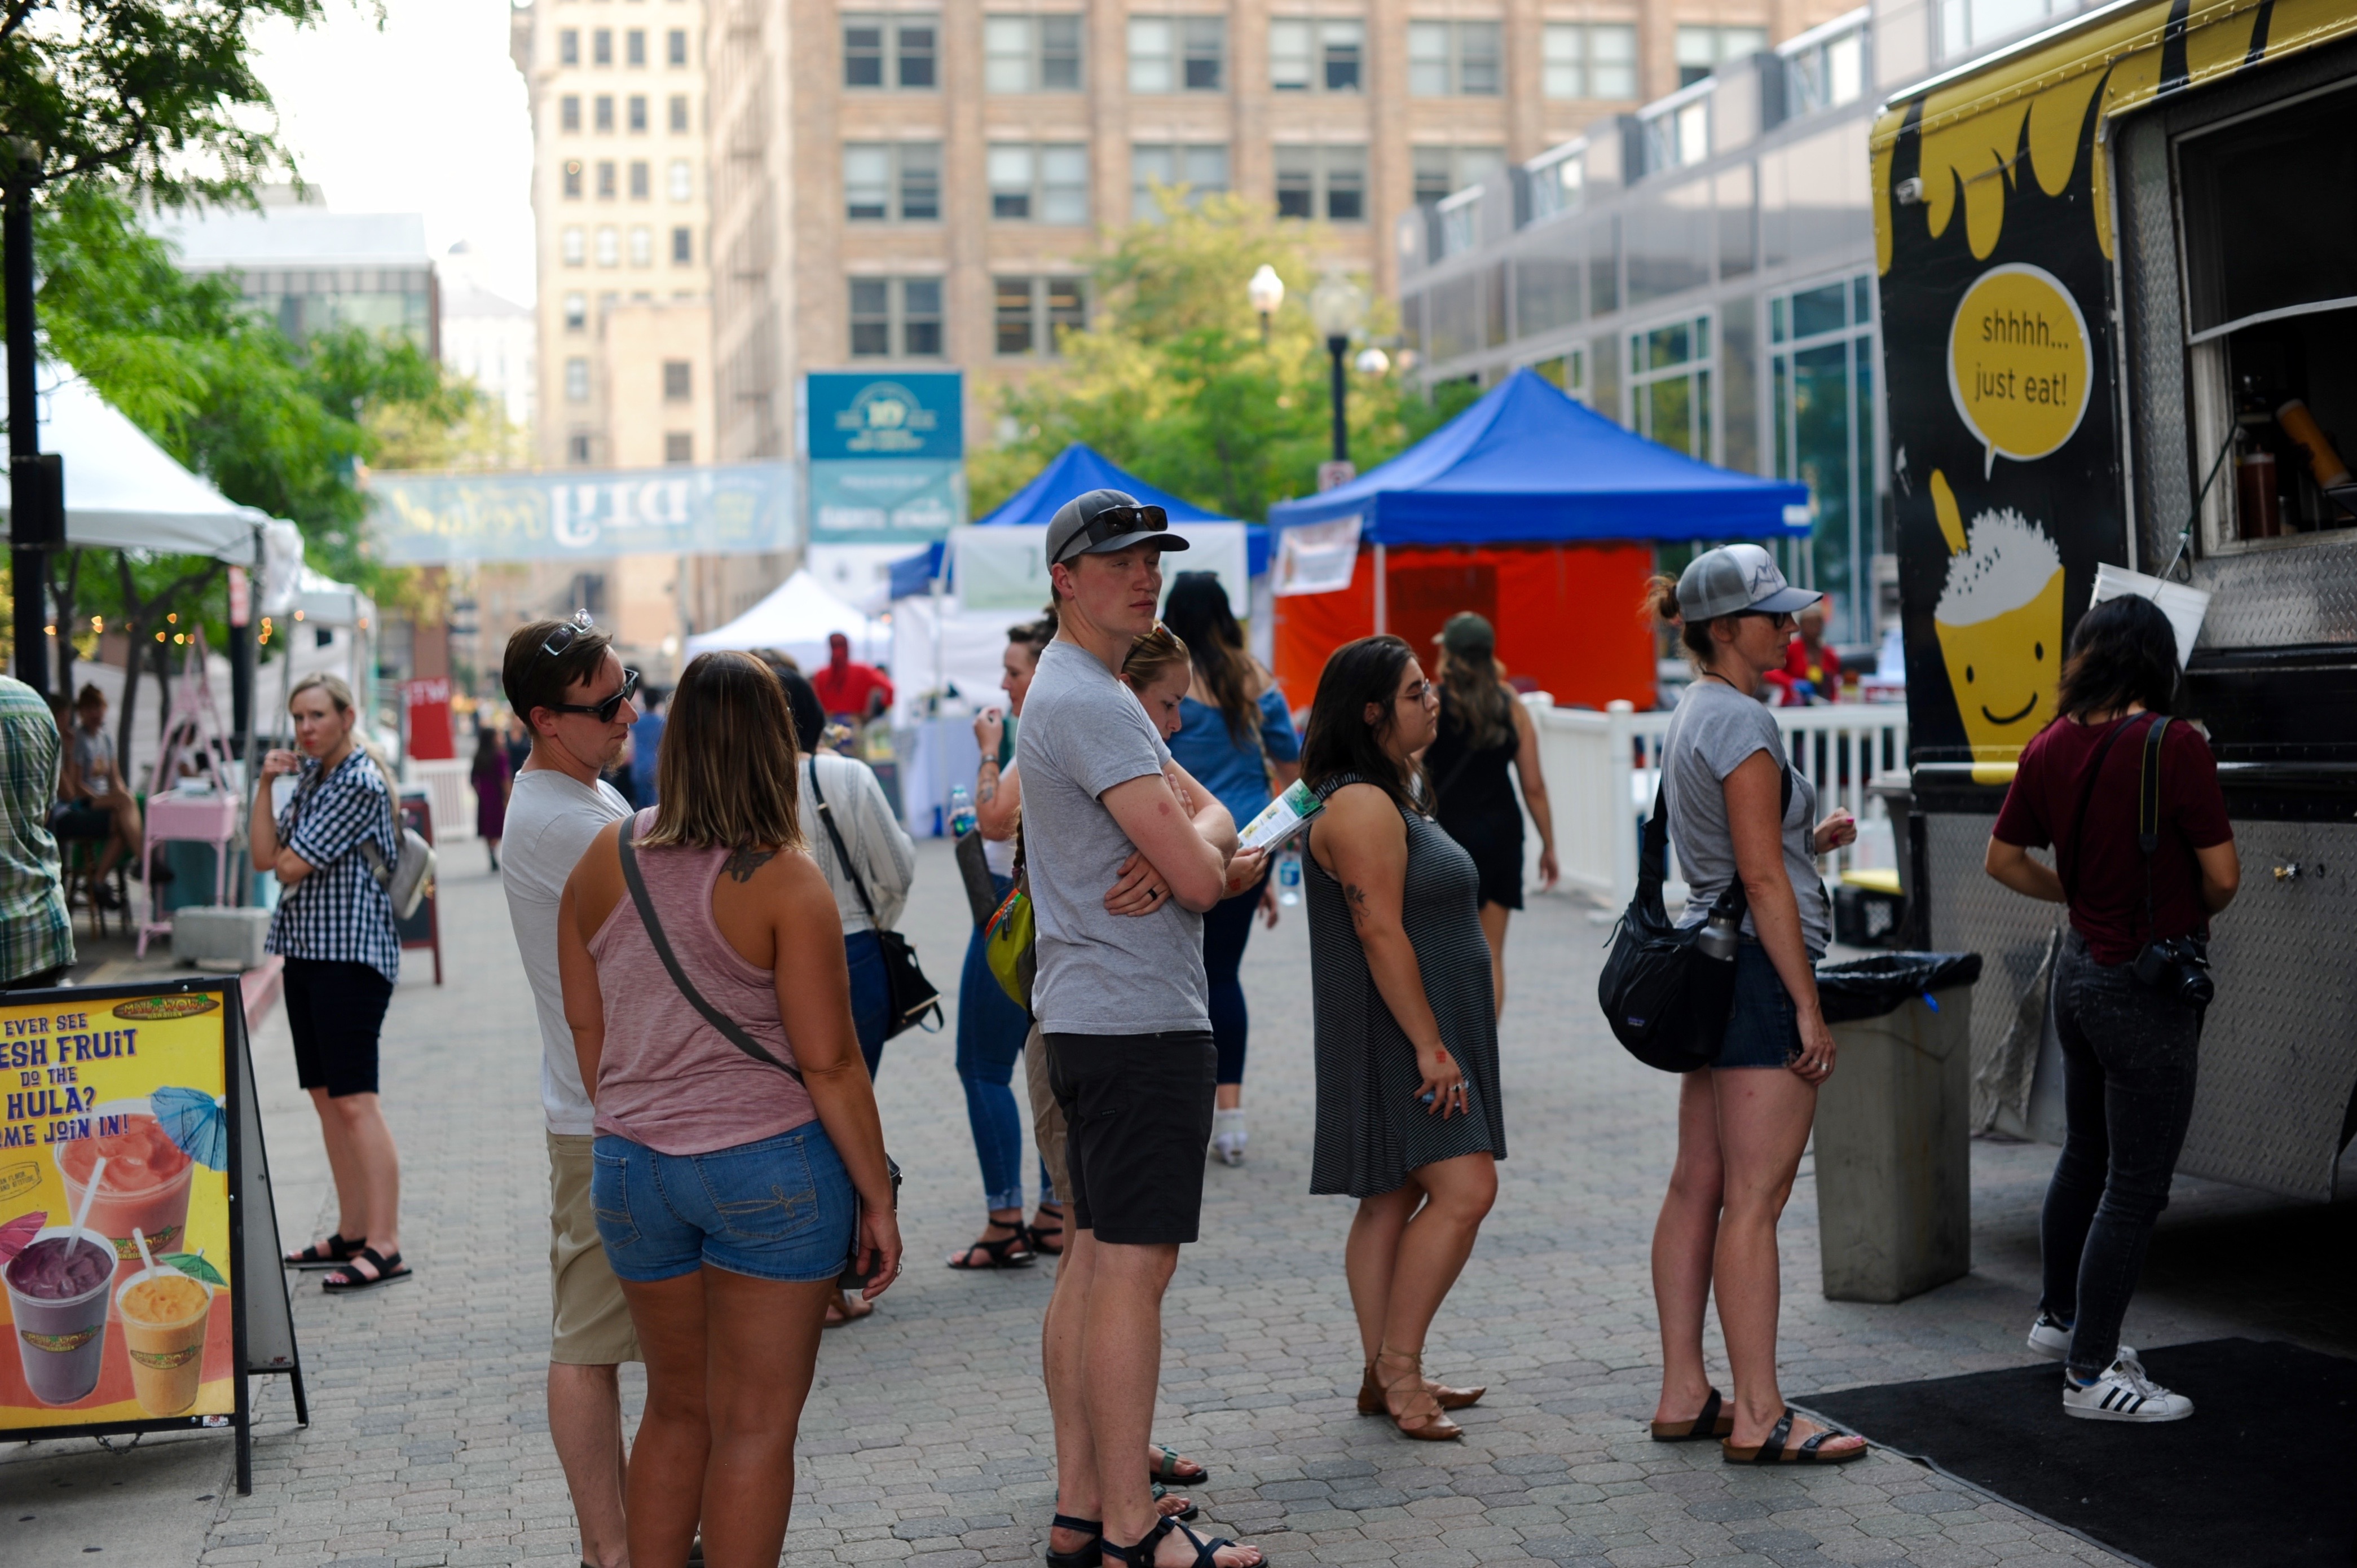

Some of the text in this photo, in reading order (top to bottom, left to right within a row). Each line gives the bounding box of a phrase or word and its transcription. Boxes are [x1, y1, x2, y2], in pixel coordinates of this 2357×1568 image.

[1982, 308, 2069, 350] shhhh...
[1975, 362, 2067, 407] just eat!
[4, 1014, 87, 1037] EVER SEE
[20, 1067, 78, 1087] DO THE
[7, 1086, 95, 1120] HULA?
[0, 1125, 36, 1148] ME
[99, 1114, 129, 1137] IN!
